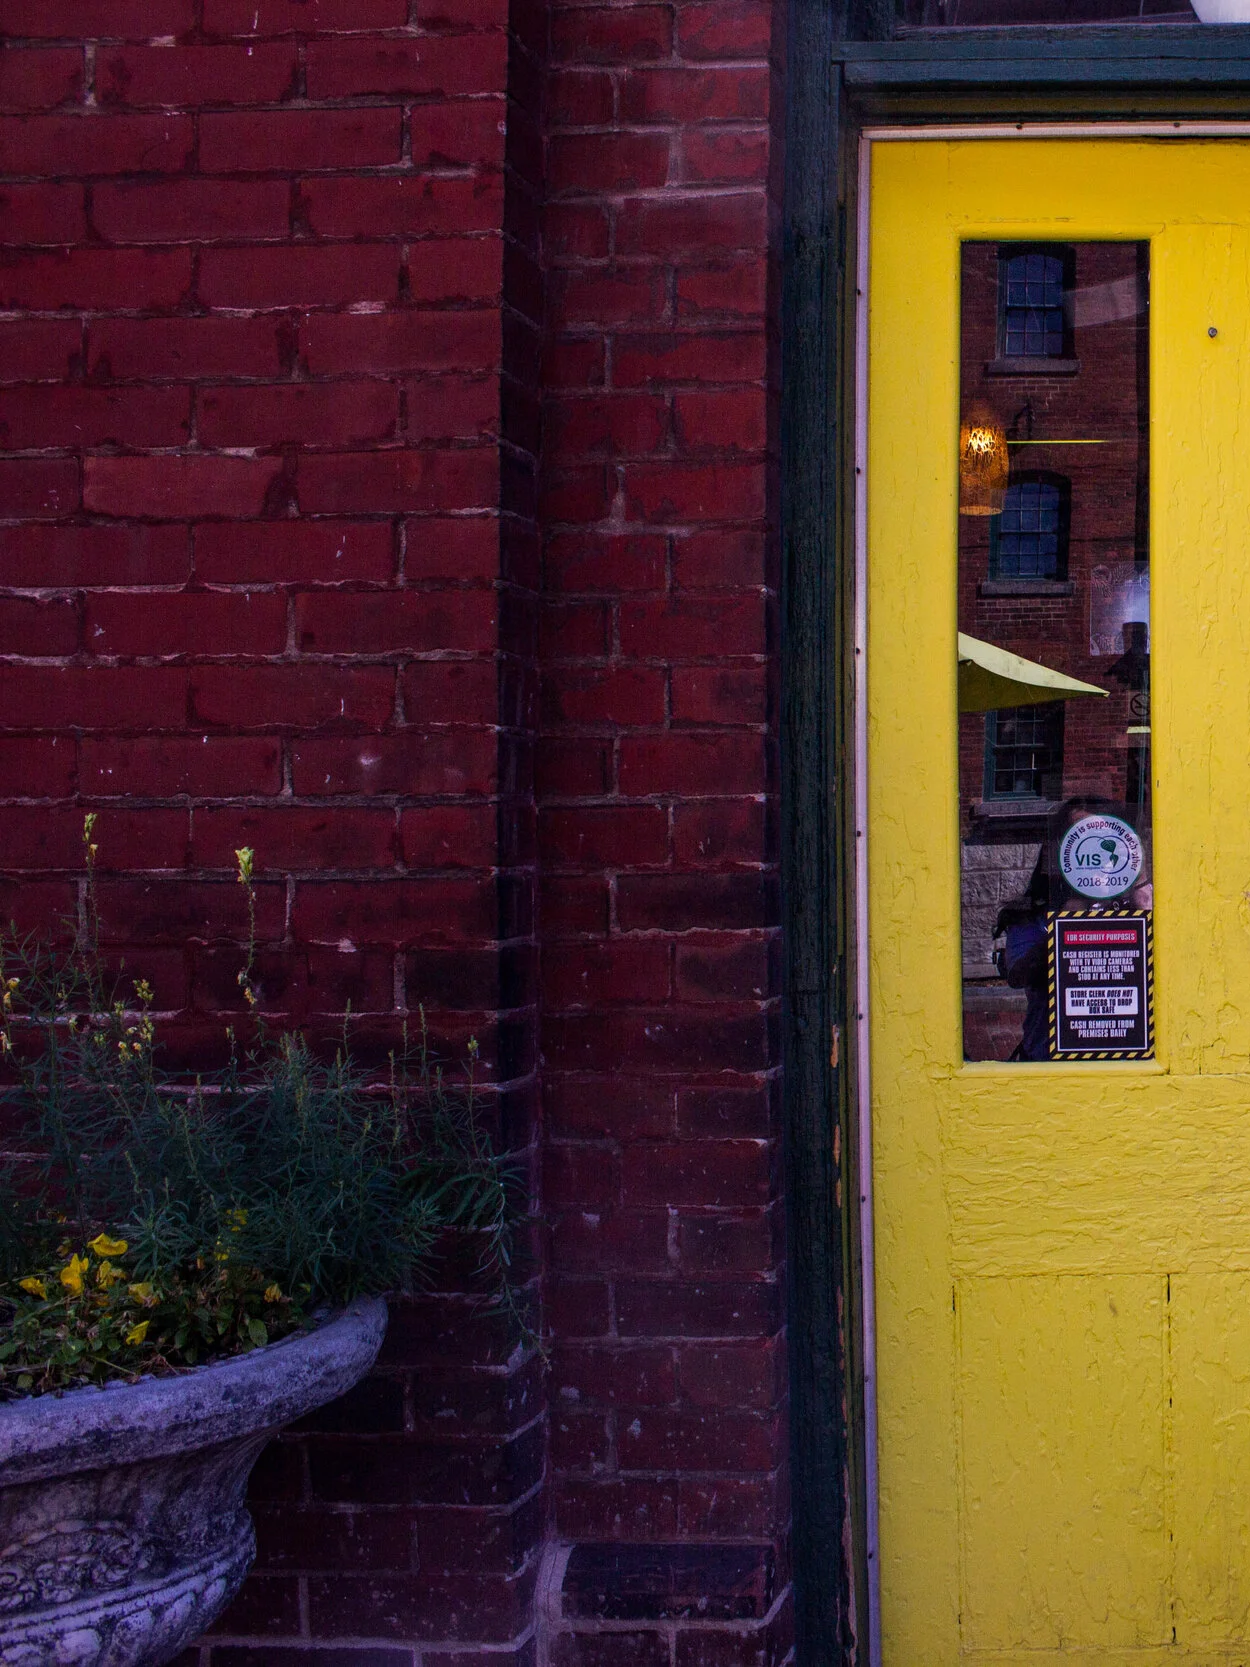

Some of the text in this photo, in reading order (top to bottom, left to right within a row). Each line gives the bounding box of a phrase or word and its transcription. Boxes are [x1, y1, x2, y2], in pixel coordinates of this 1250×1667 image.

[1064, 821, 1141, 873] Community is supporting each other
[1075, 853, 1102, 866] VIS
[1077, 876, 1129, 887] 2018-2019
[1079, 933, 1105, 941] SECURITY
[1106, 933, 1135, 941] PURPOSES
[1062, 950, 1140, 959] CASH REGISTER IS MONITORED
[1069, 958, 1083, 966] WITH
[1084, 958, 1091, 966] TV
[1068, 965, 1080, 973] AND
[1080, 965, 1106, 973] CONTAINS
[1107, 965, 1119, 973] LESS
[1111, 972, 1125, 980] TIME.
[1070, 990, 1087, 998] STORE
[1088, 990, 1105, 998] CLERK
[1122, 989, 1133, 997] NOT
[1071, 999, 1085, 1007] HAVE
[1117, 998, 1132, 1006] DROP
[1089, 1006, 1100, 1014] BOX
[1070, 1020, 1135, 1029] CASH REMOVED FROM
[1078, 1029, 1127, 1038] PREMISES DAILY
